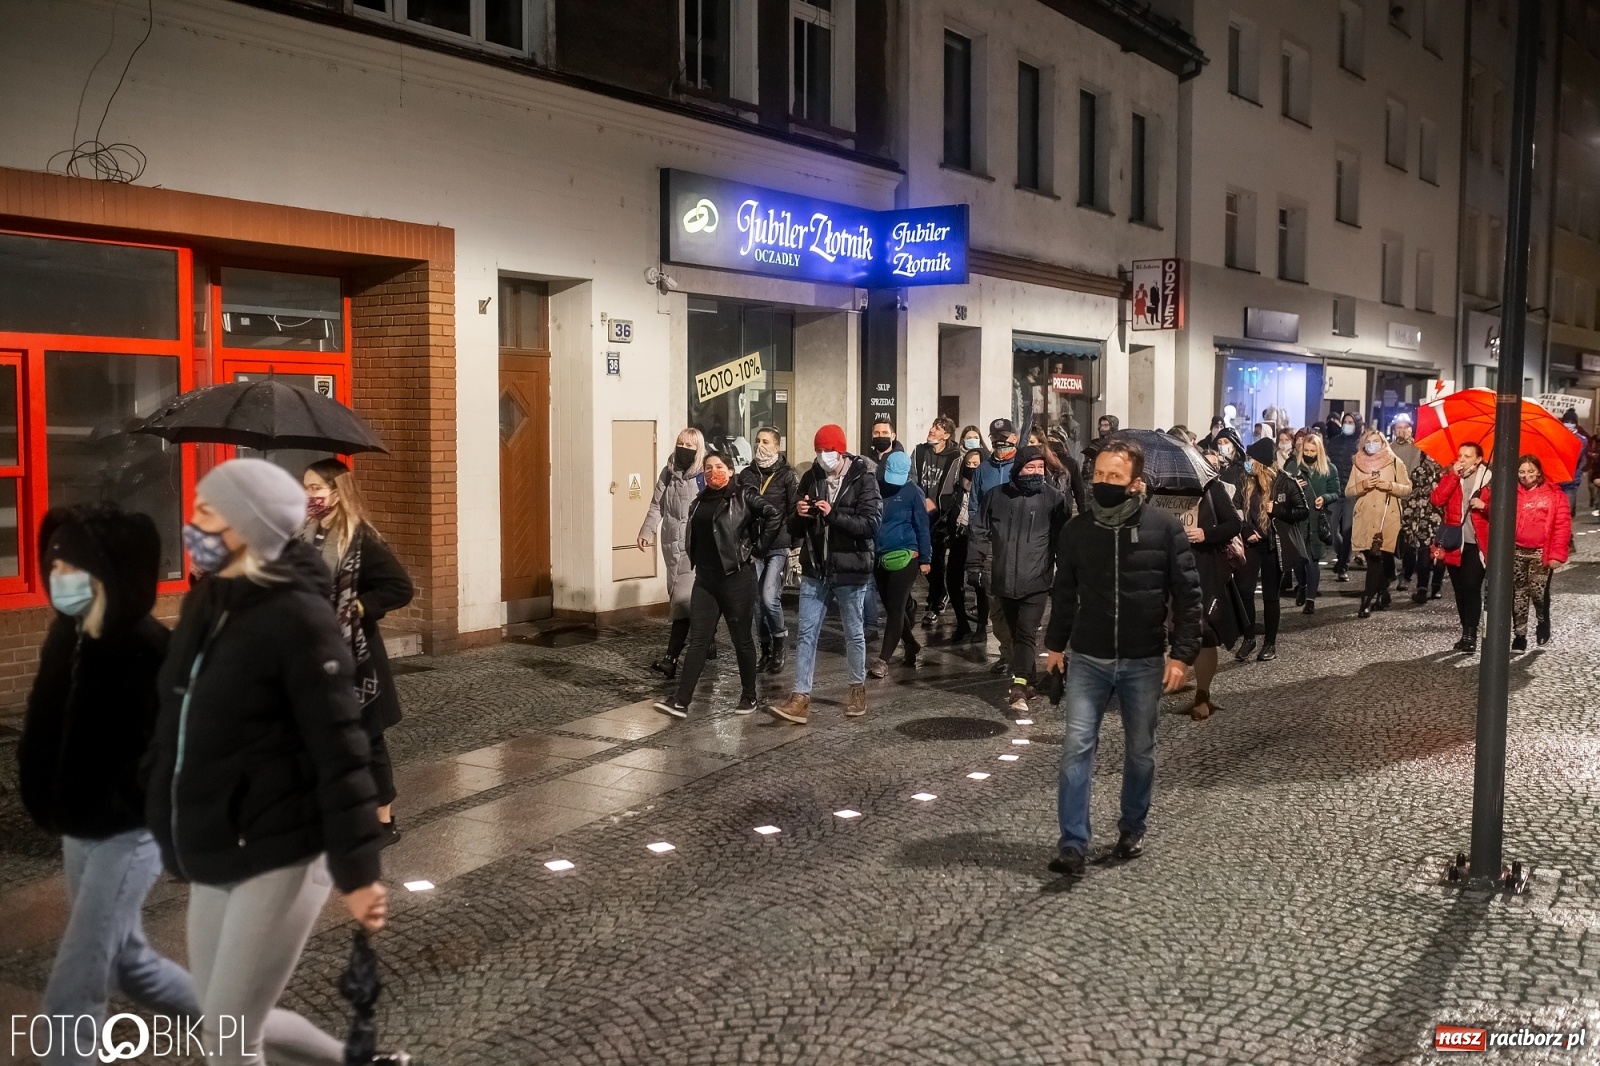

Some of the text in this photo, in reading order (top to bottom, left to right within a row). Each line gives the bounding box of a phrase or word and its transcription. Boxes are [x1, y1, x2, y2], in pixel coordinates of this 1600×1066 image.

[737, 200, 874, 262] Jubiler Złotnik
[892, 222, 952, 277] Jubiler Złotnik
[754, 249, 801, 267] OCZADŁY
[954, 305, 968, 321] 38
[615, 323, 631, 338] 36
[609, 359, 619, 370] 36
[697, 357, 761, 399] ZŁOTO -10%
[1052, 377, 1083, 391] PRZECENA
[870, 397, 895, 406] SPRZEDAŻ
